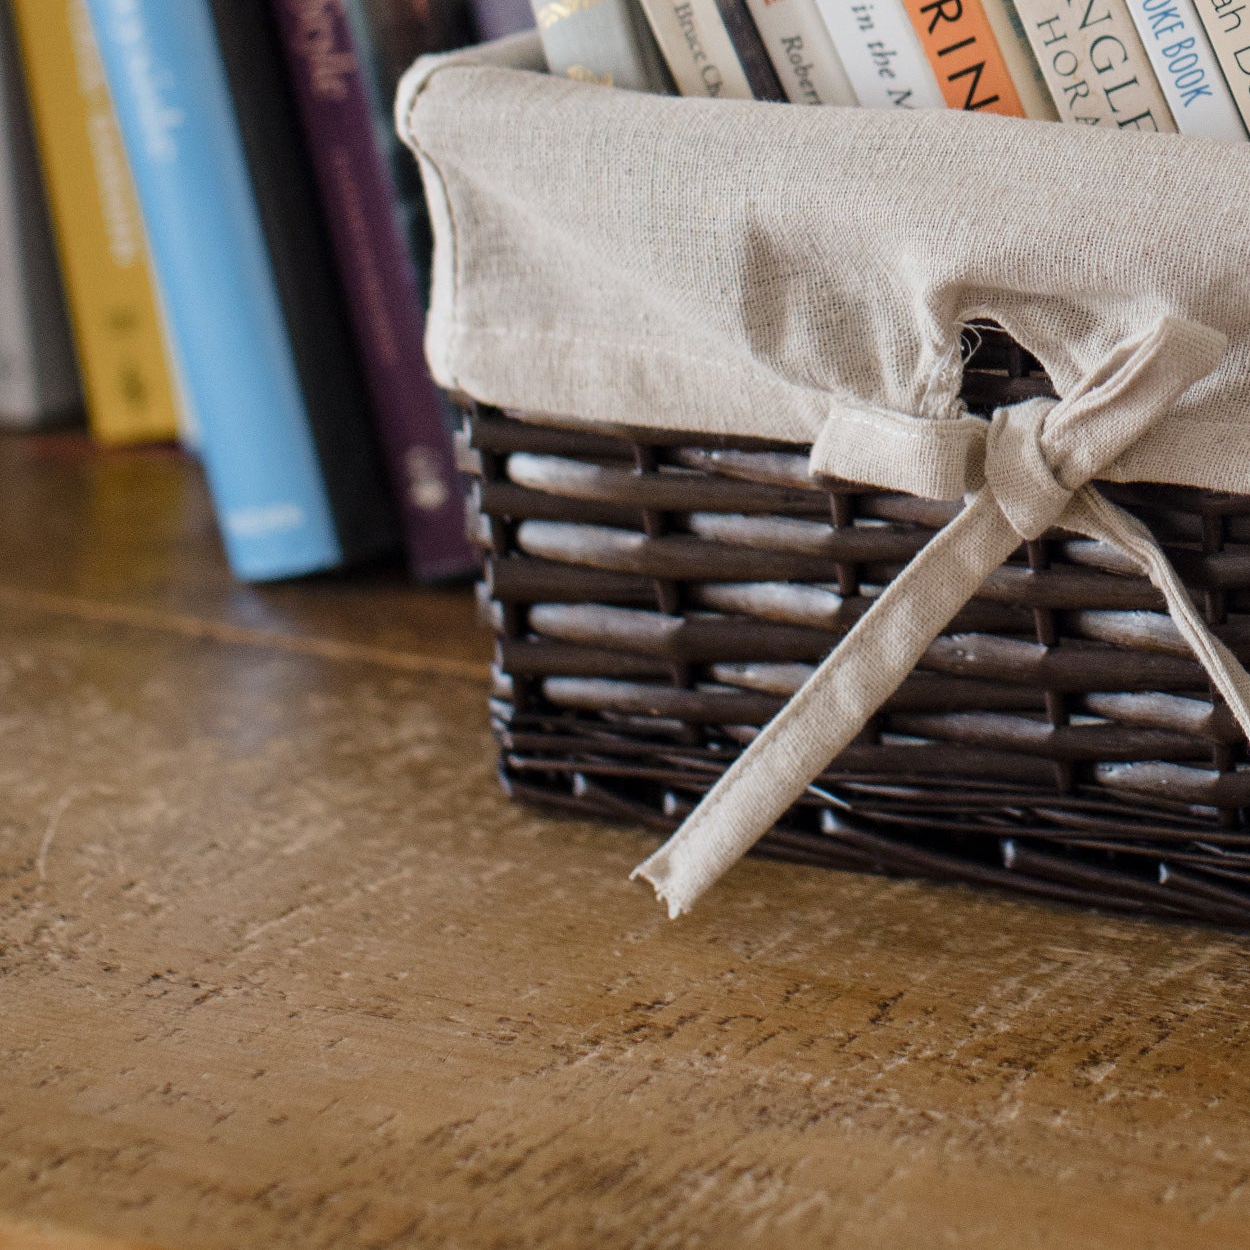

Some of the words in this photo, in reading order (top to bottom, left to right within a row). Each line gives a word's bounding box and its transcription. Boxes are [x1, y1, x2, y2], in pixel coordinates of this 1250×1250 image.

[851, 4, 875, 31] in
[867, 41, 897, 79] the
[1161, 37, 1213, 109] BOOK
